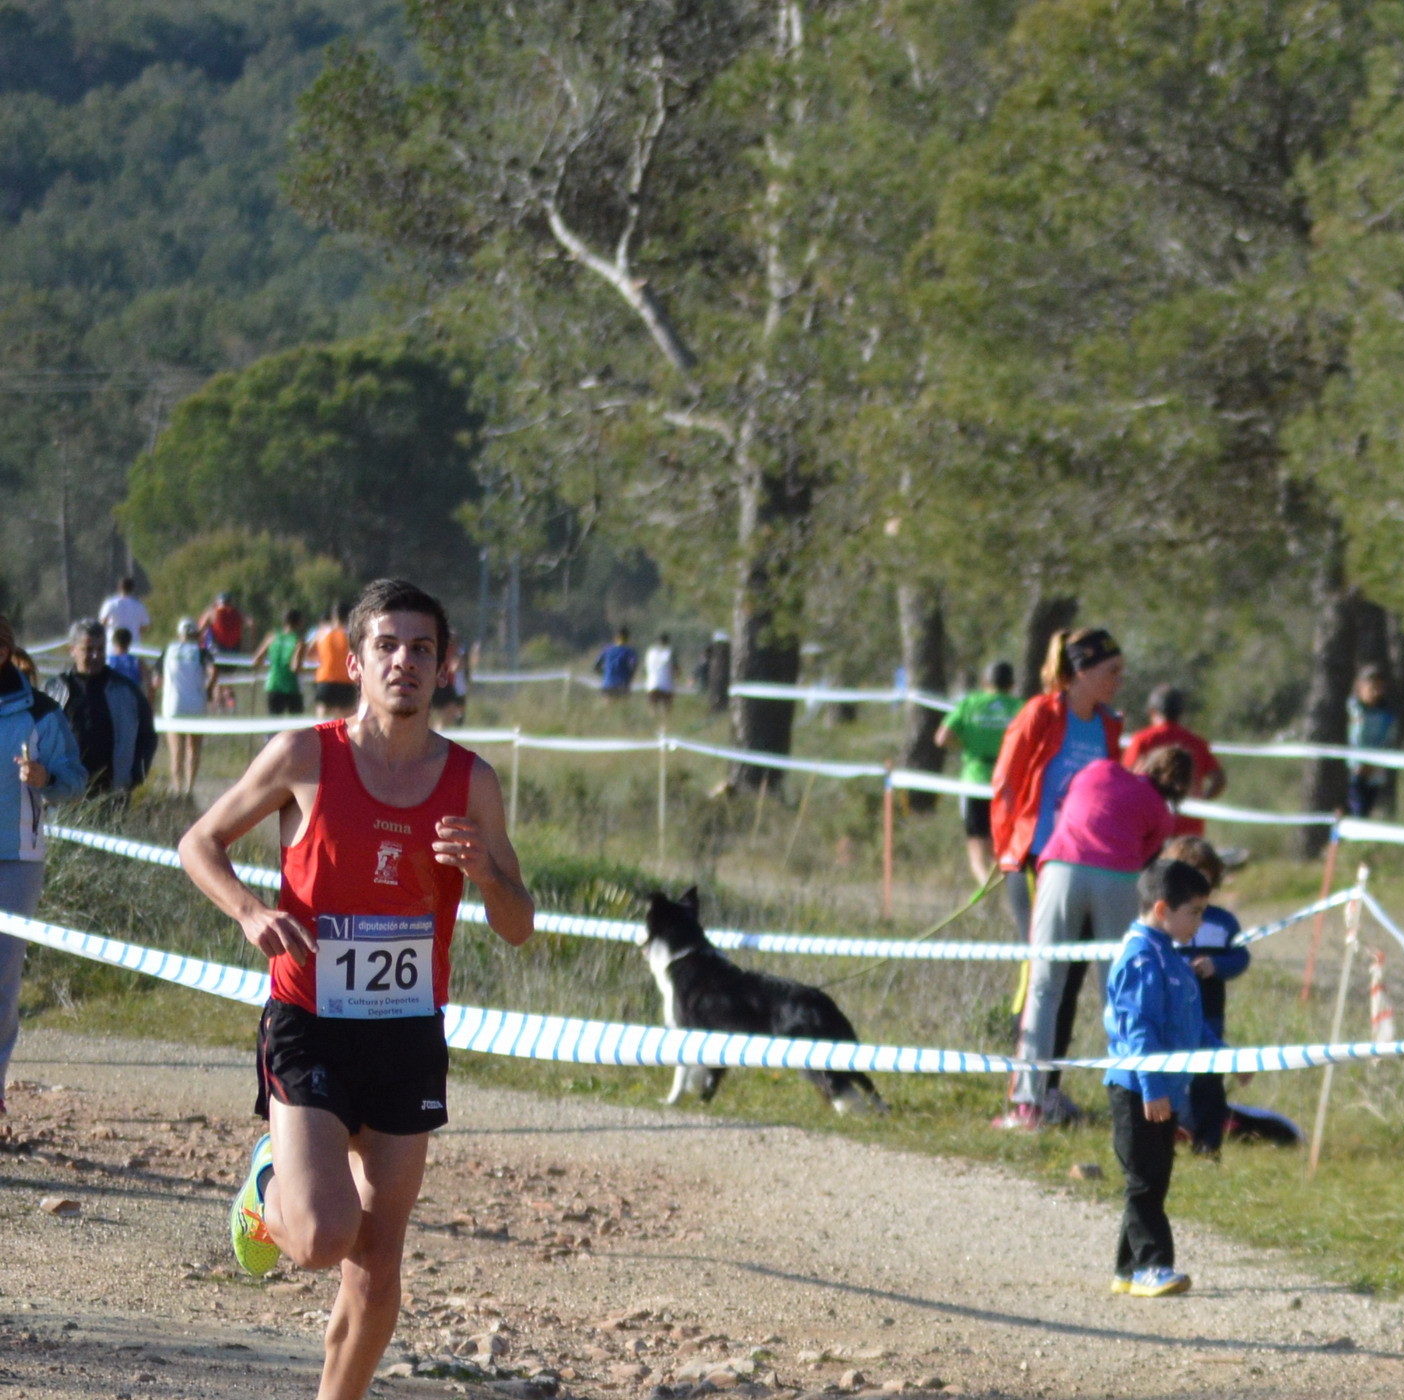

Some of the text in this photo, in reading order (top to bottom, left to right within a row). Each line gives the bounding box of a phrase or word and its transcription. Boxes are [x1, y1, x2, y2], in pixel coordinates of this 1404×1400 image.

[373, 819, 412, 834] Joma
[358, 920, 398, 933] diputación
[399, 921, 409, 930] de
[335, 948, 419, 992] 126
[347, 997, 379, 1006] Cultura
[385, 996, 420, 1006] Deportes
[368, 1008, 403, 1017] Deportes
